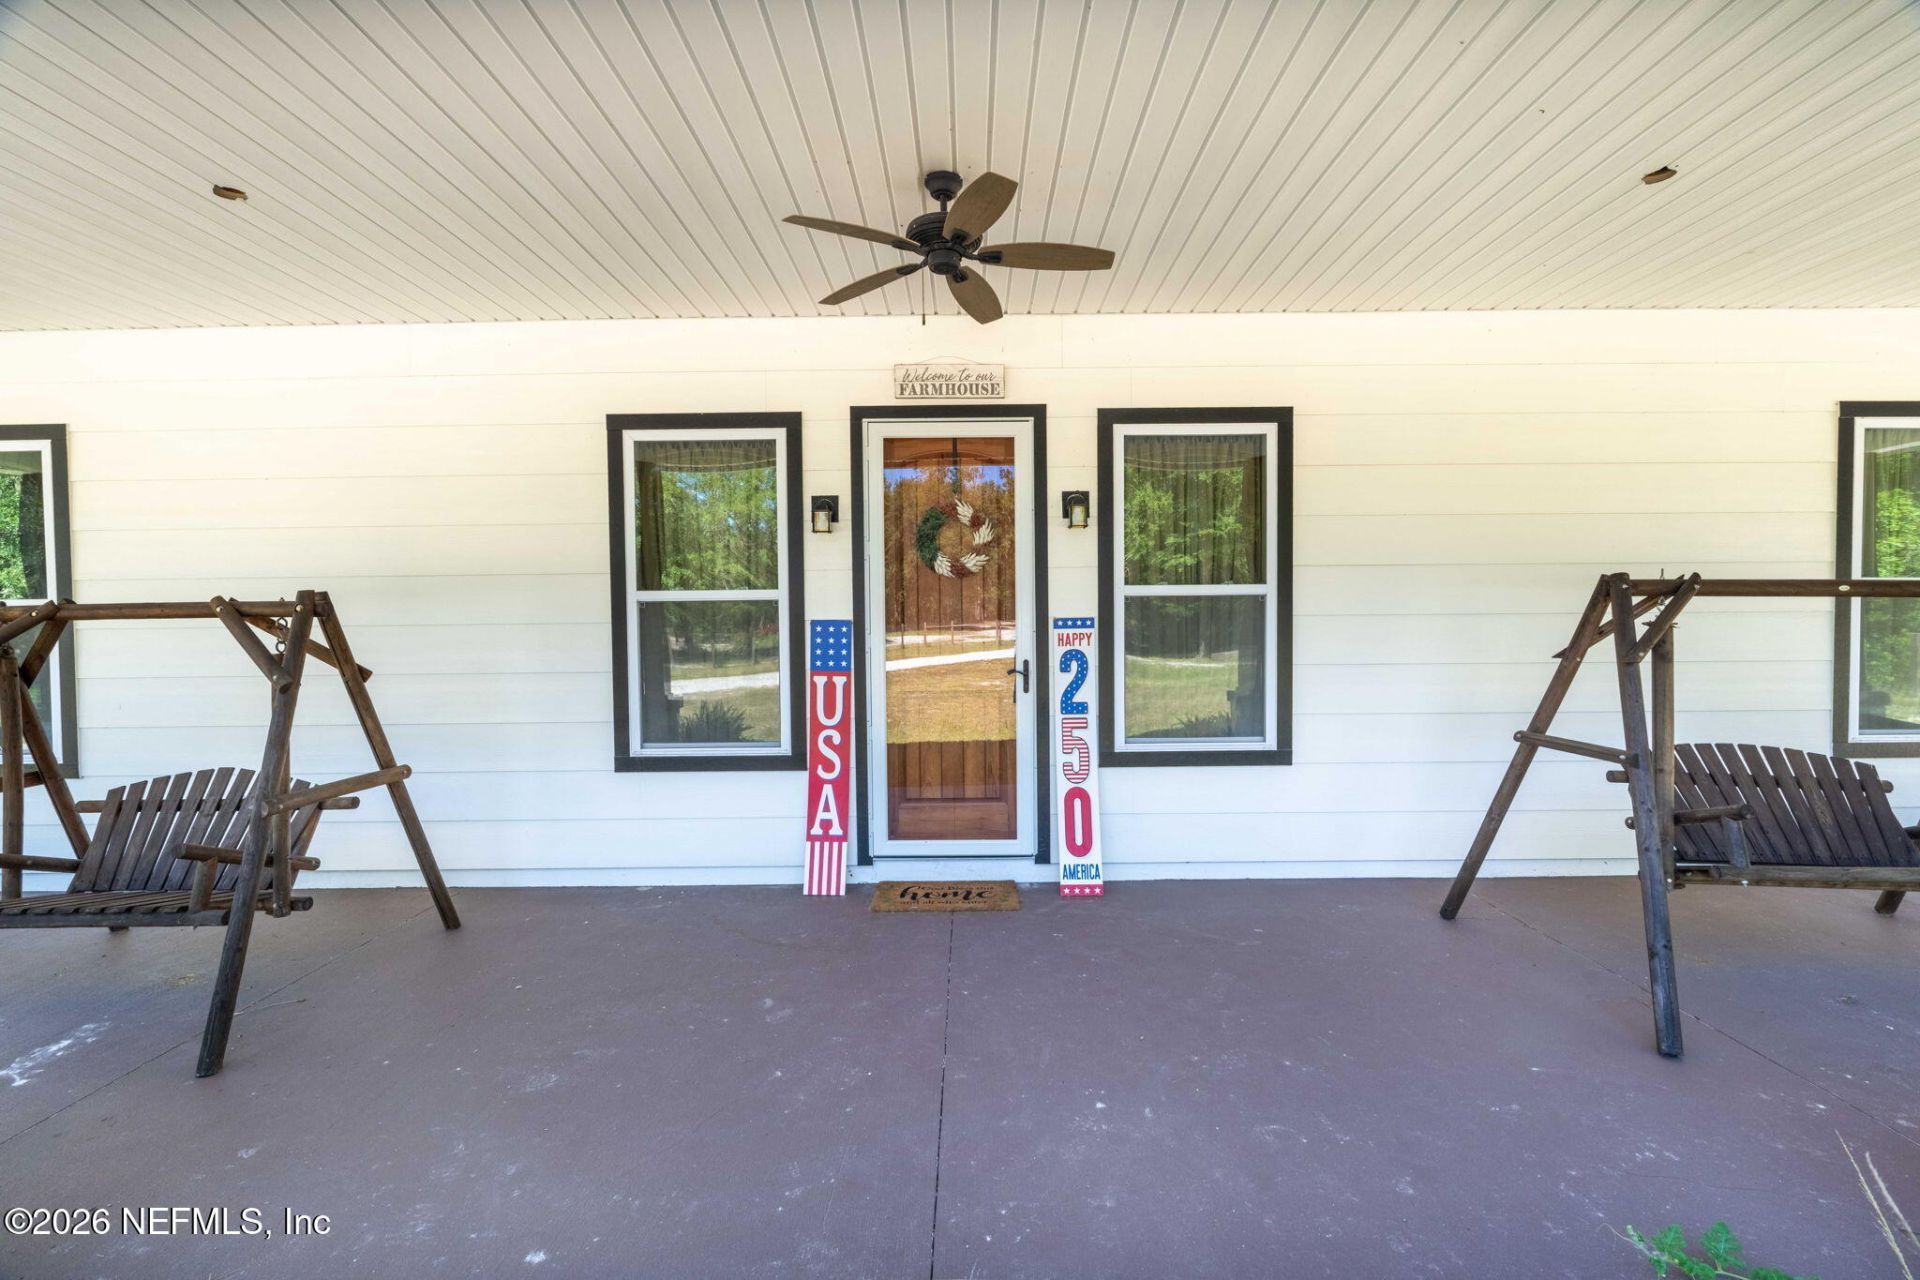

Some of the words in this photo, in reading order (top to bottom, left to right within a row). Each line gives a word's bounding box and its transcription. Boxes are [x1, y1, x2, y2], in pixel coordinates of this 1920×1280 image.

[902, 367, 957, 382] Welcome
[958, 368, 972, 382] to
[975, 371, 996, 382] our
[899, 383, 1000, 396] FARMHOUSE
[1057, 632, 1093, 647] HAPPY
[810, 675, 848, 836] USA
[1059, 648, 1094, 858] 250
[1062, 863, 1101, 881] AMERICA
